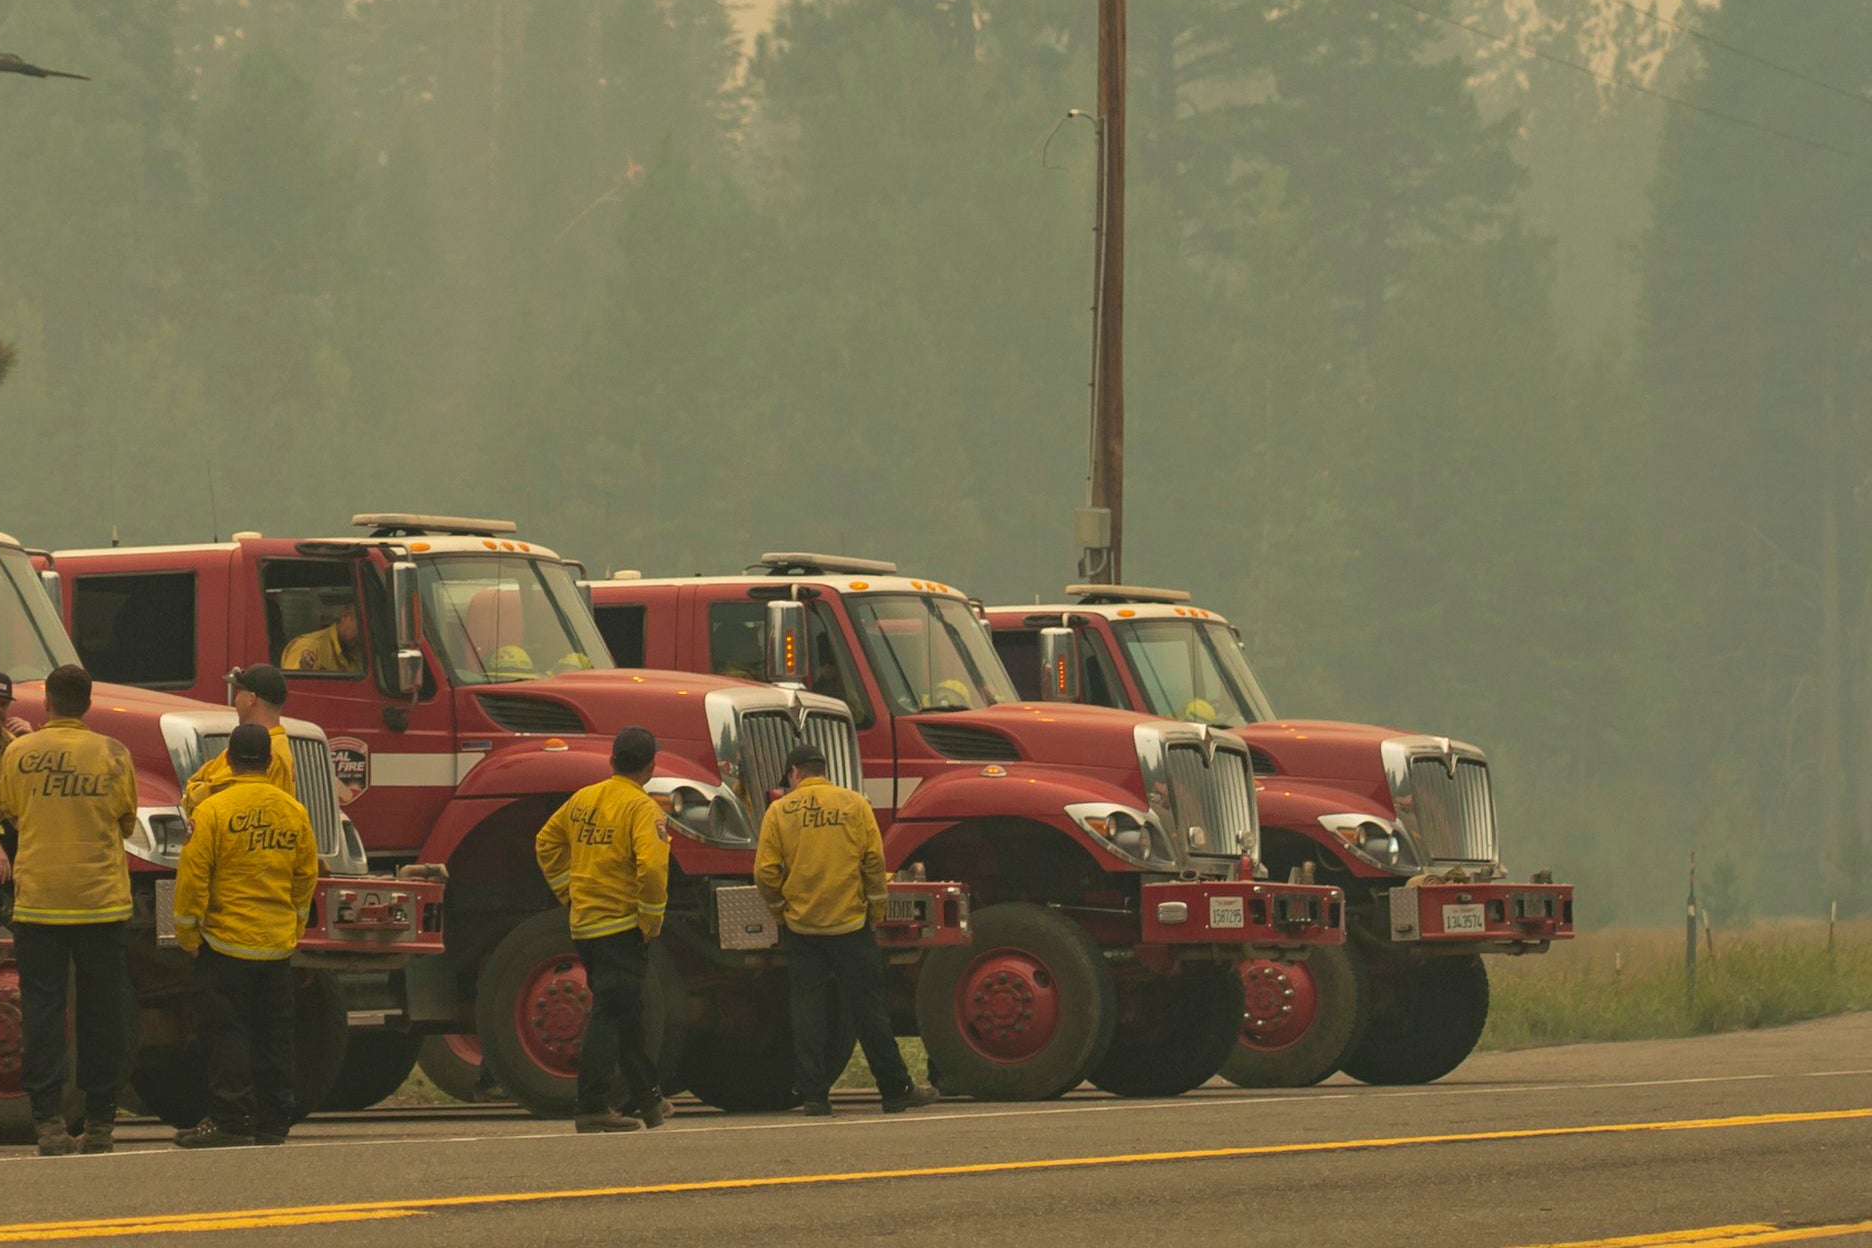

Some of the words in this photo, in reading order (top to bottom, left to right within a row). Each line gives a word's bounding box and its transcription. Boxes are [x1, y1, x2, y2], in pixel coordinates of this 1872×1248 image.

[18, 750, 77, 774] CAL
[337, 761, 365, 772] FIRE
[43, 773, 113, 797] FIRE
[570, 805, 599, 826] CAL
[783, 795, 822, 814] CAL
[229, 808, 272, 833] CAL
[802, 809, 848, 828] FIRE
[248, 828, 298, 851] FIRE
